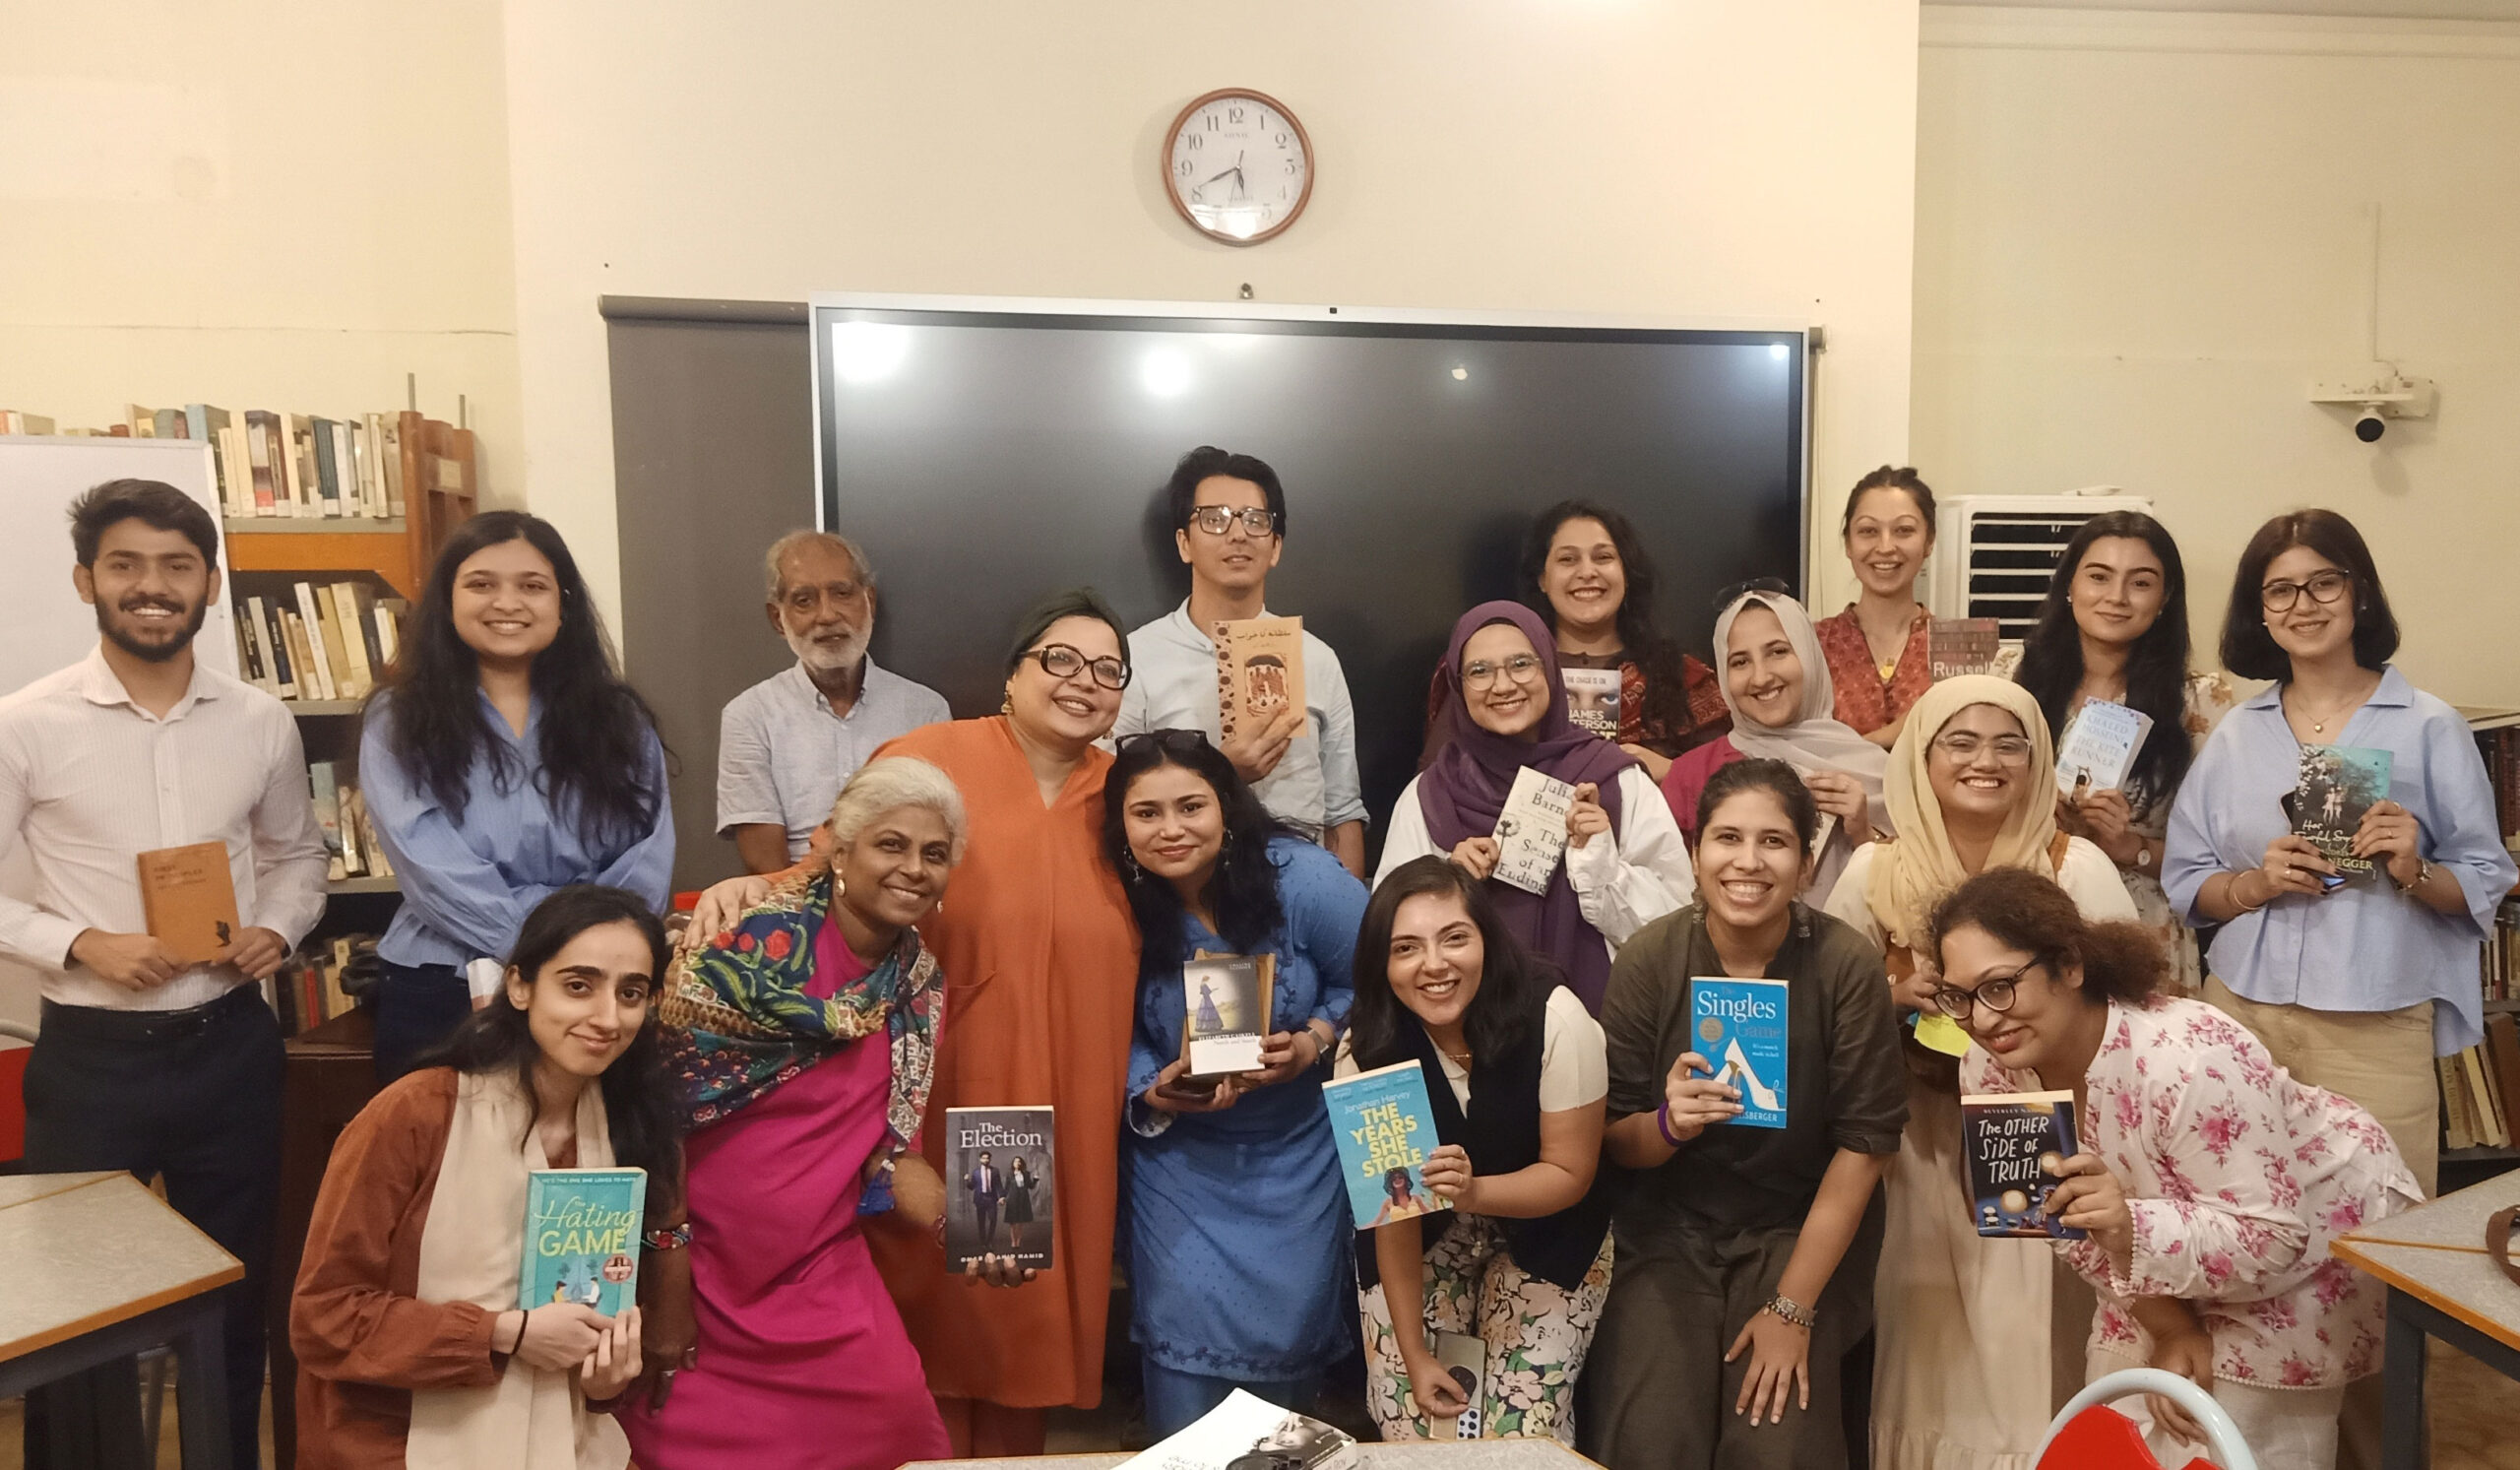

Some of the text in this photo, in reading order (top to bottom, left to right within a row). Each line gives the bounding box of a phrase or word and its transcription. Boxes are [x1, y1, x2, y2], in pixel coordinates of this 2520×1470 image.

[1207, 114, 1220, 132] 11
[1228, 106, 1244, 124] 12
[1260, 114, 1264, 130] 1
[1187, 133, 1203, 150] 10
[1275, 133, 1287, 149] 2
[1181, 160, 1193, 176] 9
[1285, 159, 1295, 175] 3
[1191, 185, 1203, 202] 8
[1261, 203, 1272, 220] 5
[1539, 778, 1573, 799] Juli
[1532, 793, 1565, 816] Barn
[2302, 818, 2323, 831] Her
[1540, 828, 1567, 850] The
[1522, 838, 1560, 863] Sense
[1519, 859, 1534, 870] of
[2328, 857, 2374, 871] NEGGER
[1497, 862, 1547, 895] Ending
[1697, 991, 1776, 1023] Singles
[1344, 1090, 1411, 1115] Jonathan Harvey
[1359, 1102, 1400, 1125] THE
[1738, 1111, 1778, 1122] SBERGER
[978, 1121, 1003, 1133] The
[1350, 1115, 1418, 1145] YEARS
[1978, 1116, 2049, 1137] The OTHER
[960, 1128, 1042, 1149] Election
[1368, 1134, 1409, 1160] SHE
[1361, 1148, 1423, 1178] STOLE
[1987, 1157, 2041, 1184] TRUTH
[534, 1195, 638, 1237] Hating
[538, 1228, 627, 1257] GAME
